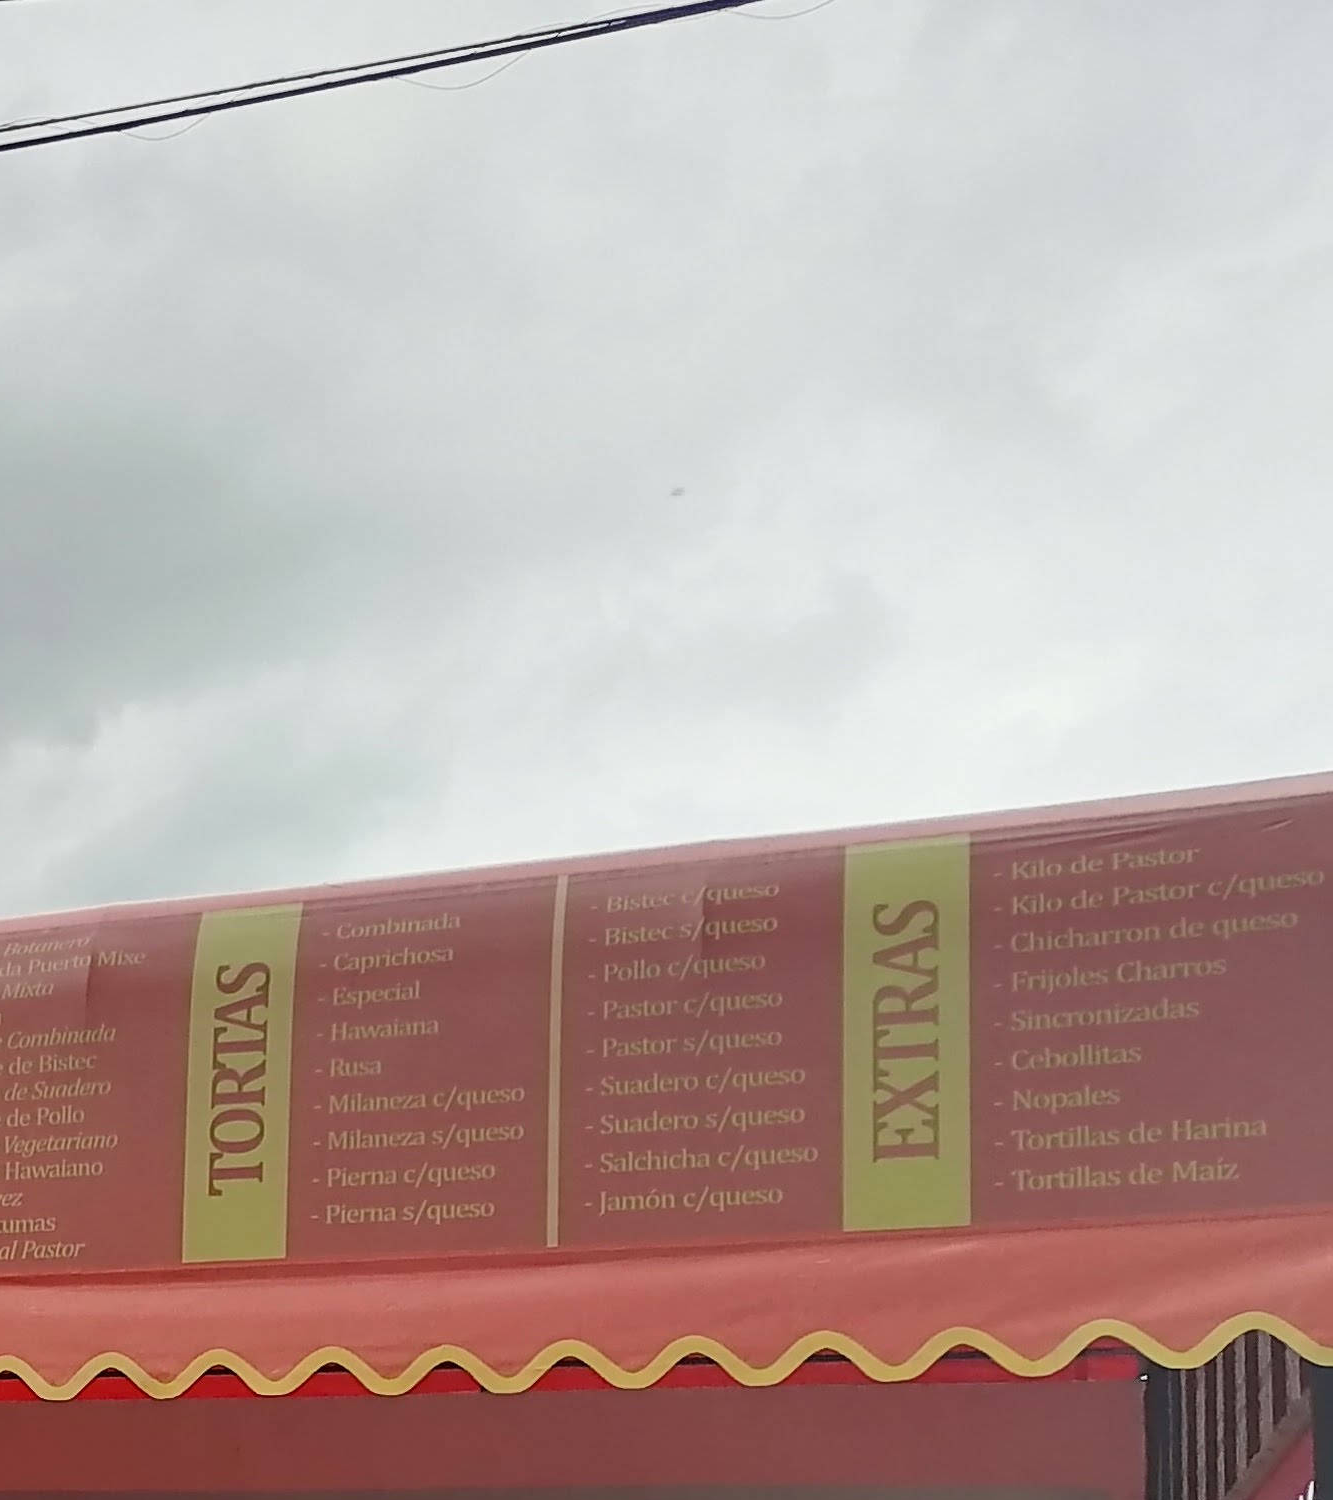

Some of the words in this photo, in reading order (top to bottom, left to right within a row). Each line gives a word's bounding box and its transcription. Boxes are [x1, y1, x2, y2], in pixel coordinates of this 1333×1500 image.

[1011, 855, 1063, 880] Kilo
[1071, 854, 1104, 875] de
[1112, 846, 1200, 871] Pastor
[606, 894, 673, 914] Bistec
[681, 883, 780, 912] c/queso
[1011, 894, 1063, 917] Kilo
[1071, 888, 1104, 909] de
[1112, 881, 1201, 907] Pastor
[1207, 867, 1326, 901] c/queso
[336, 913, 461, 939] Combinada
[604, 925, 673, 947] Bistec
[679, 915, 779, 941] s/queso
[1010, 926, 1161, 953] Chicharron
[1170, 918, 1204, 938] de
[1212, 911, 1299, 941] queso
[334, 946, 454, 973] Caprichosa
[604, 961, 661, 984] Pollo
[667, 953, 766, 983] c/queso
[1011, 966, 1109, 996] Frijoles
[1116, 956, 1228, 985] Charros
[333, 981, 421, 1009] Especial
[603, 1000, 678, 1021] Pastor
[684, 991, 784, 1019] c/queso
[331, 1018, 440, 1042] Hawaiana
[1010, 997, 1200, 1033] Sincronizadas
[7, 1023, 117, 1048] Combinada
[601, 1036, 677, 1059] Pastor
[682, 1029, 784, 1057] s/queso
[872, 899, 940, 1164] EXTRAS
[9, 1059, 33, 1077] de
[39, 1054, 99, 1074] Bistec
[330, 1057, 382, 1078] Rusa
[1011, 1043, 1142, 1072] Cebollitas
[5, 1083, 28, 1102] de
[32, 1079, 111, 1099] Suadero
[209, 962, 271, 1197] TORTAS
[600, 1072, 699, 1098] Suadero
[705, 1066, 806, 1093] c/queso
[328, 1092, 427, 1114] Milaneza
[432, 1086, 525, 1113] c/queso
[1012, 1085, 1122, 1115] Nopales
[6, 1110, 31, 1128] de
[37, 1106, 85, 1125] Pollo
[600, 1112, 697, 1135] Suadero
[705, 1105, 805, 1131] s/queso
[4, 1131, 118, 1157] Vegetariano
[327, 1128, 425, 1151] Milaneza
[431, 1123, 525, 1149] s/queso
[1011, 1124, 1120, 1153] Tortillas
[1128, 1122, 1163, 1145] de
[1172, 1117, 1269, 1143] Harina
[5, 1160, 103, 1180] Hawaiano
[600, 1148, 710, 1174] Salchicha
[717, 1144, 819, 1173] c/queso
[326, 1165, 397, 1188] Pierna
[403, 1161, 496, 1188] c/queso
[1011, 1164, 1121, 1193] Tortillas
[1128, 1162, 1163, 1186] de
[1172, 1156, 1240, 1184] Maíz
[325, 1202, 396, 1224] Pierna
[401, 1199, 495, 1225] s/queso
[598, 1188, 675, 1216] Jamón
[682, 1185, 784, 1213] c/queso
[21, 1239, 86, 1260] Pastor
